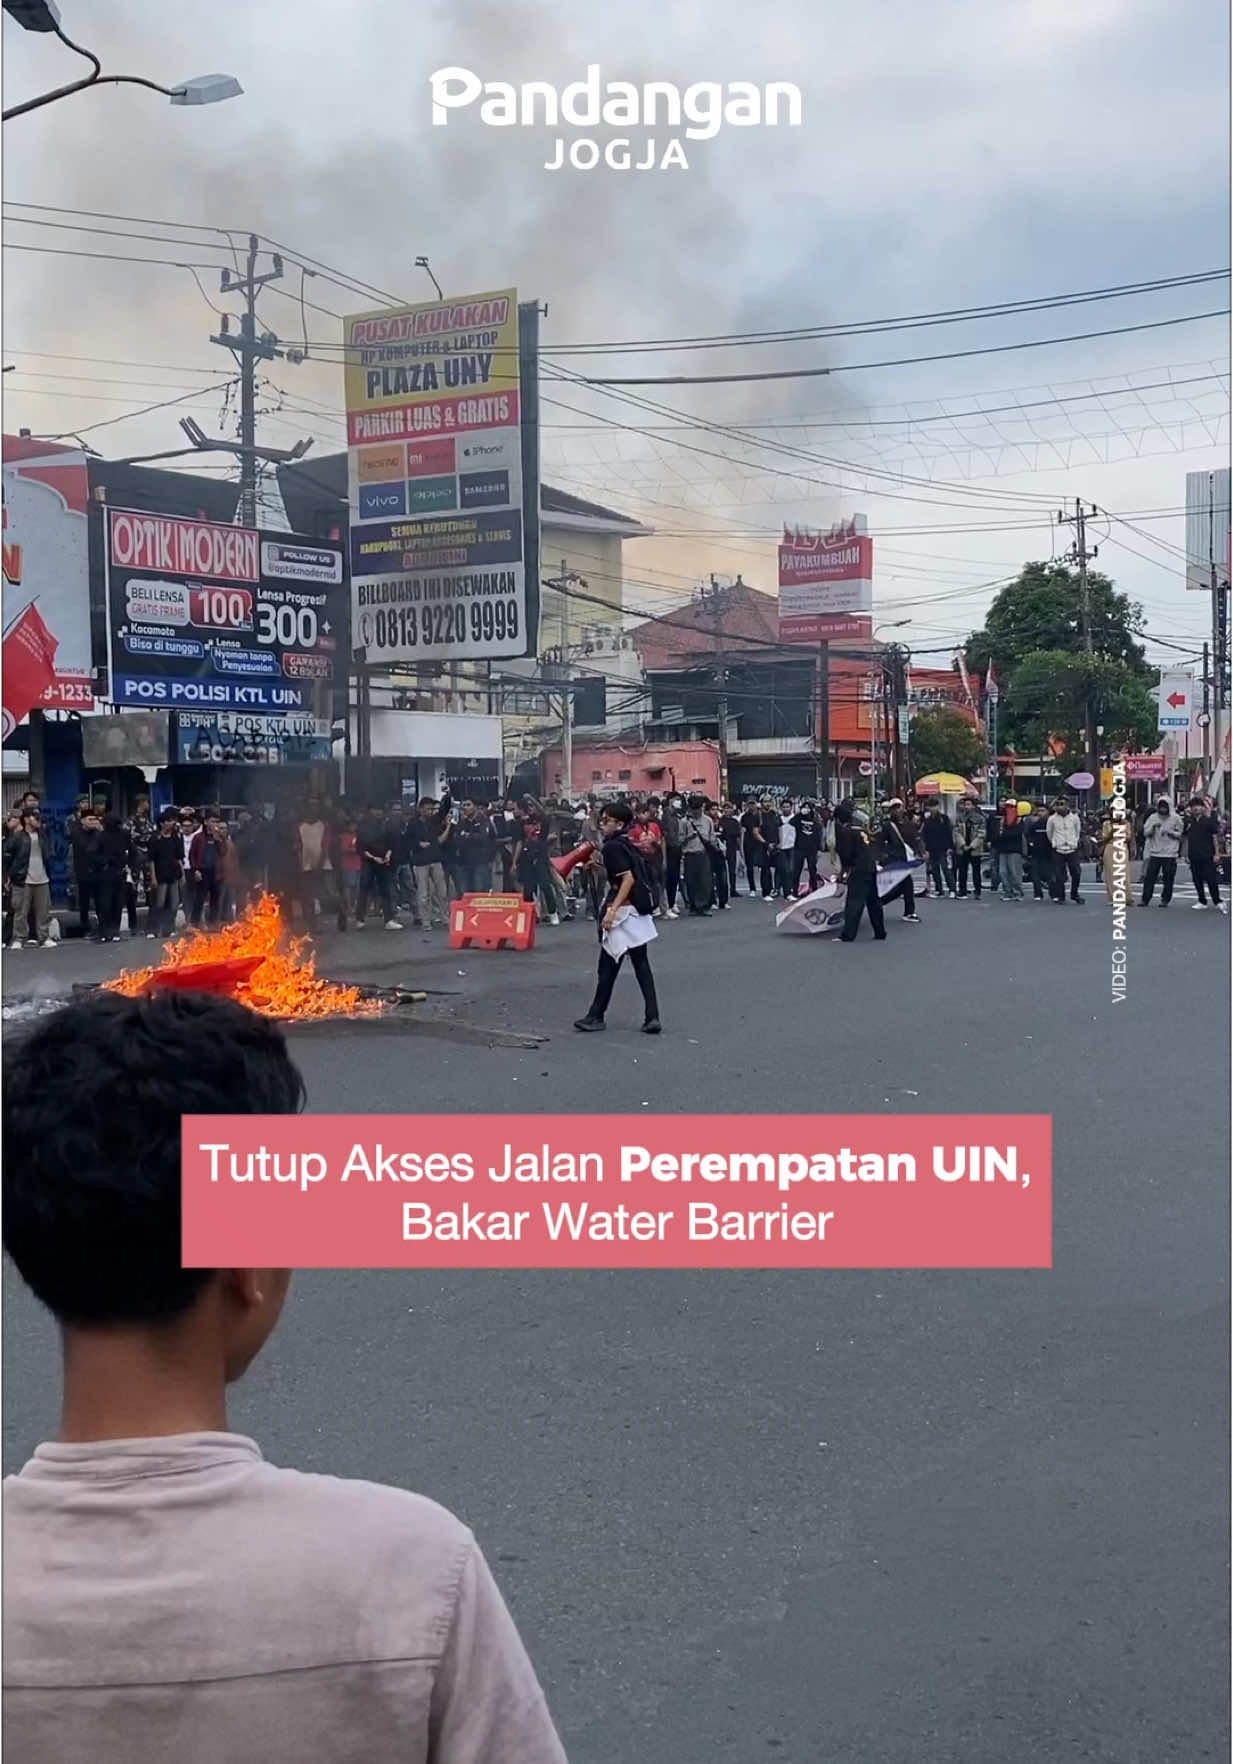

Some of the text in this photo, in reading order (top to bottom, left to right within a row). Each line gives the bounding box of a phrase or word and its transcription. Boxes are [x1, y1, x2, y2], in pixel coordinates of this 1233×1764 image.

[354, 300, 507, 343] PUSAT KULAKAN
[454, 331, 498, 351] LAPTOP
[367, 353, 494, 399] PLAZA UNY
[355, 411, 404, 439] PARKIR
[407, 404, 441, 431] LUAS
[458, 396, 508, 425] GRATIS
[366, 495, 399, 508] vivo
[113, 516, 256, 579] OPTIK MODERN
[283, 551, 331, 563] FOLLOW US
[131, 587, 185, 603] BELI LENSA
[257, 588, 327, 607] Lensa Progresif
[358, 571, 515, 606] BILLBOARD INI DISEWAKAN
[198, 589, 245, 627] 100
[256, 603, 318, 648] 300
[376, 599, 518, 648] 0813 9220 9999
[130, 637, 199, 654] Bisa di tunggu
[124, 680, 302, 705] POS POLISI KTL UIN
[235, 717, 316, 735] POS KTL UIN
